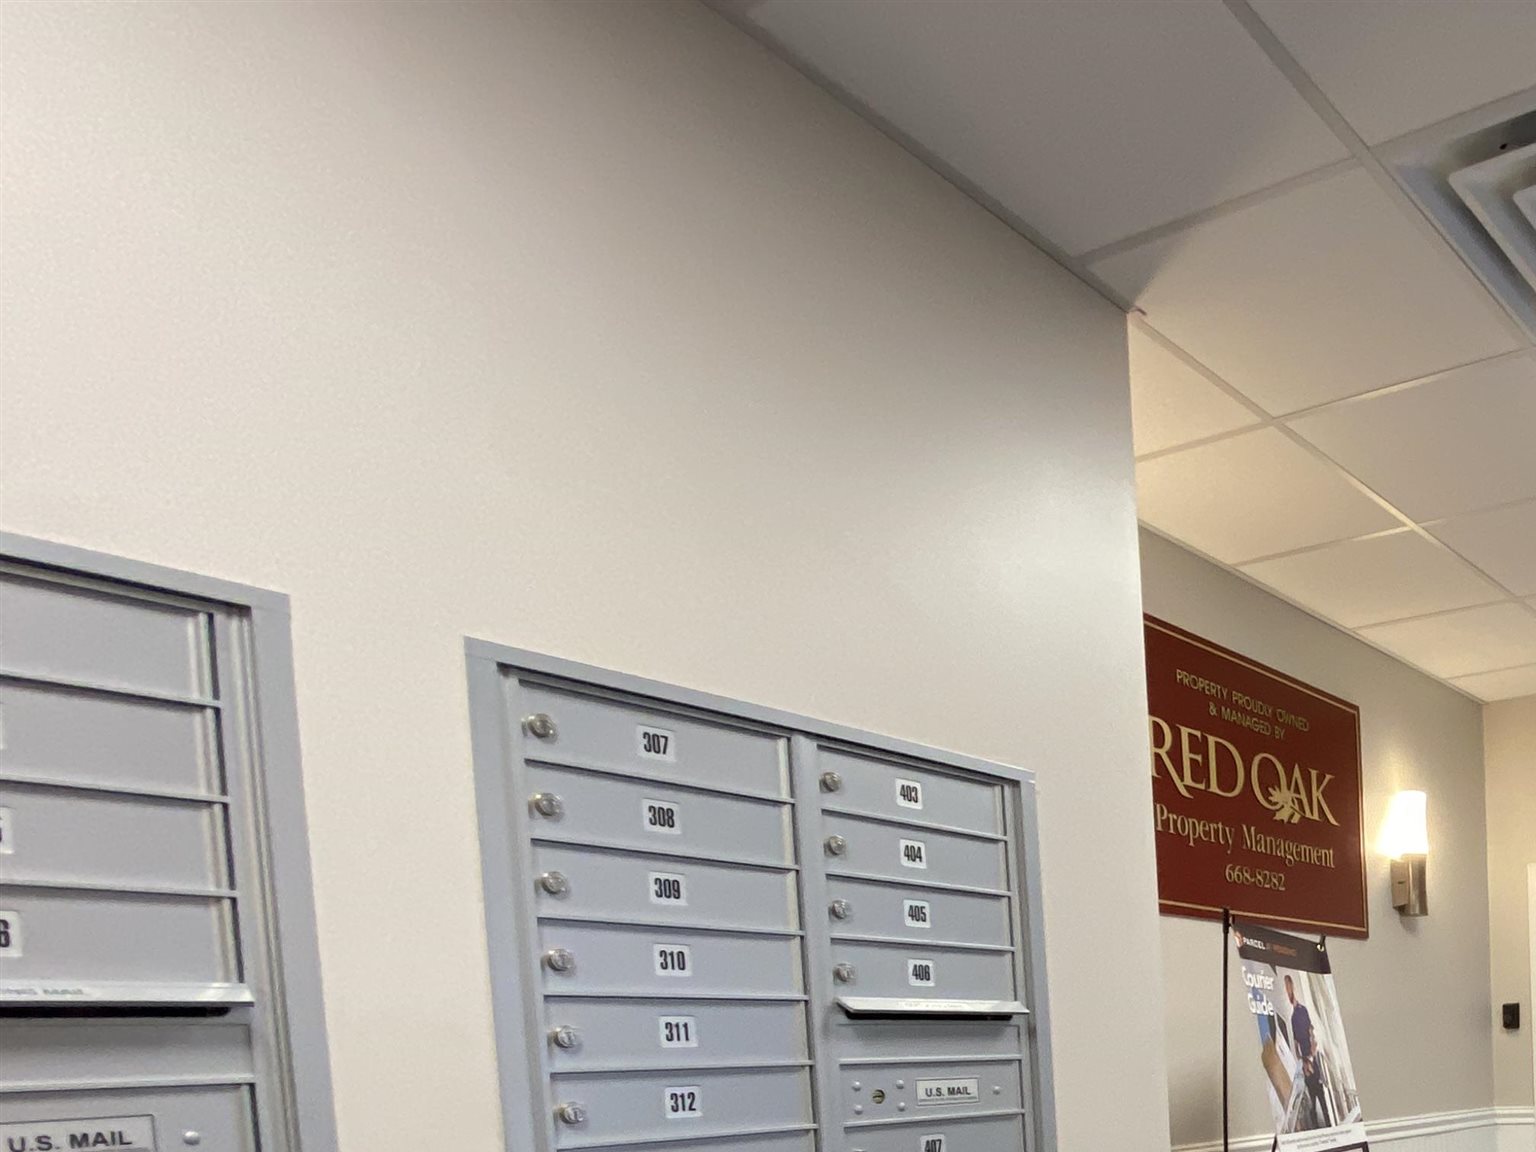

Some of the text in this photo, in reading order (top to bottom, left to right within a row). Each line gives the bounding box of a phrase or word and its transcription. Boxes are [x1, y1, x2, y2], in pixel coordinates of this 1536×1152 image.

[1176, 669, 1309, 732] PROPERTY PROUDLY OWNED
[1209, 702, 1286, 739] & MANAGED BY
[642, 731, 669, 755] 307
[1149, 715, 1340, 826] RED OAK
[899, 784, 919, 804] 403
[648, 805, 675, 828] 308
[1155, 803, 1335, 868] Property Management
[903, 844, 923, 863] 404
[1225, 863, 1286, 891] 668-8282
[654, 877, 681, 900] 309
[908, 904, 927, 923] 405
[659, 949, 686, 971] 310
[665, 1021, 690, 1042] 311
[670, 1091, 697, 1113] 312
[924, 1085, 971, 1098] U.S. MAIL
[8, 1131, 133, 1152] U.S. MAIL
